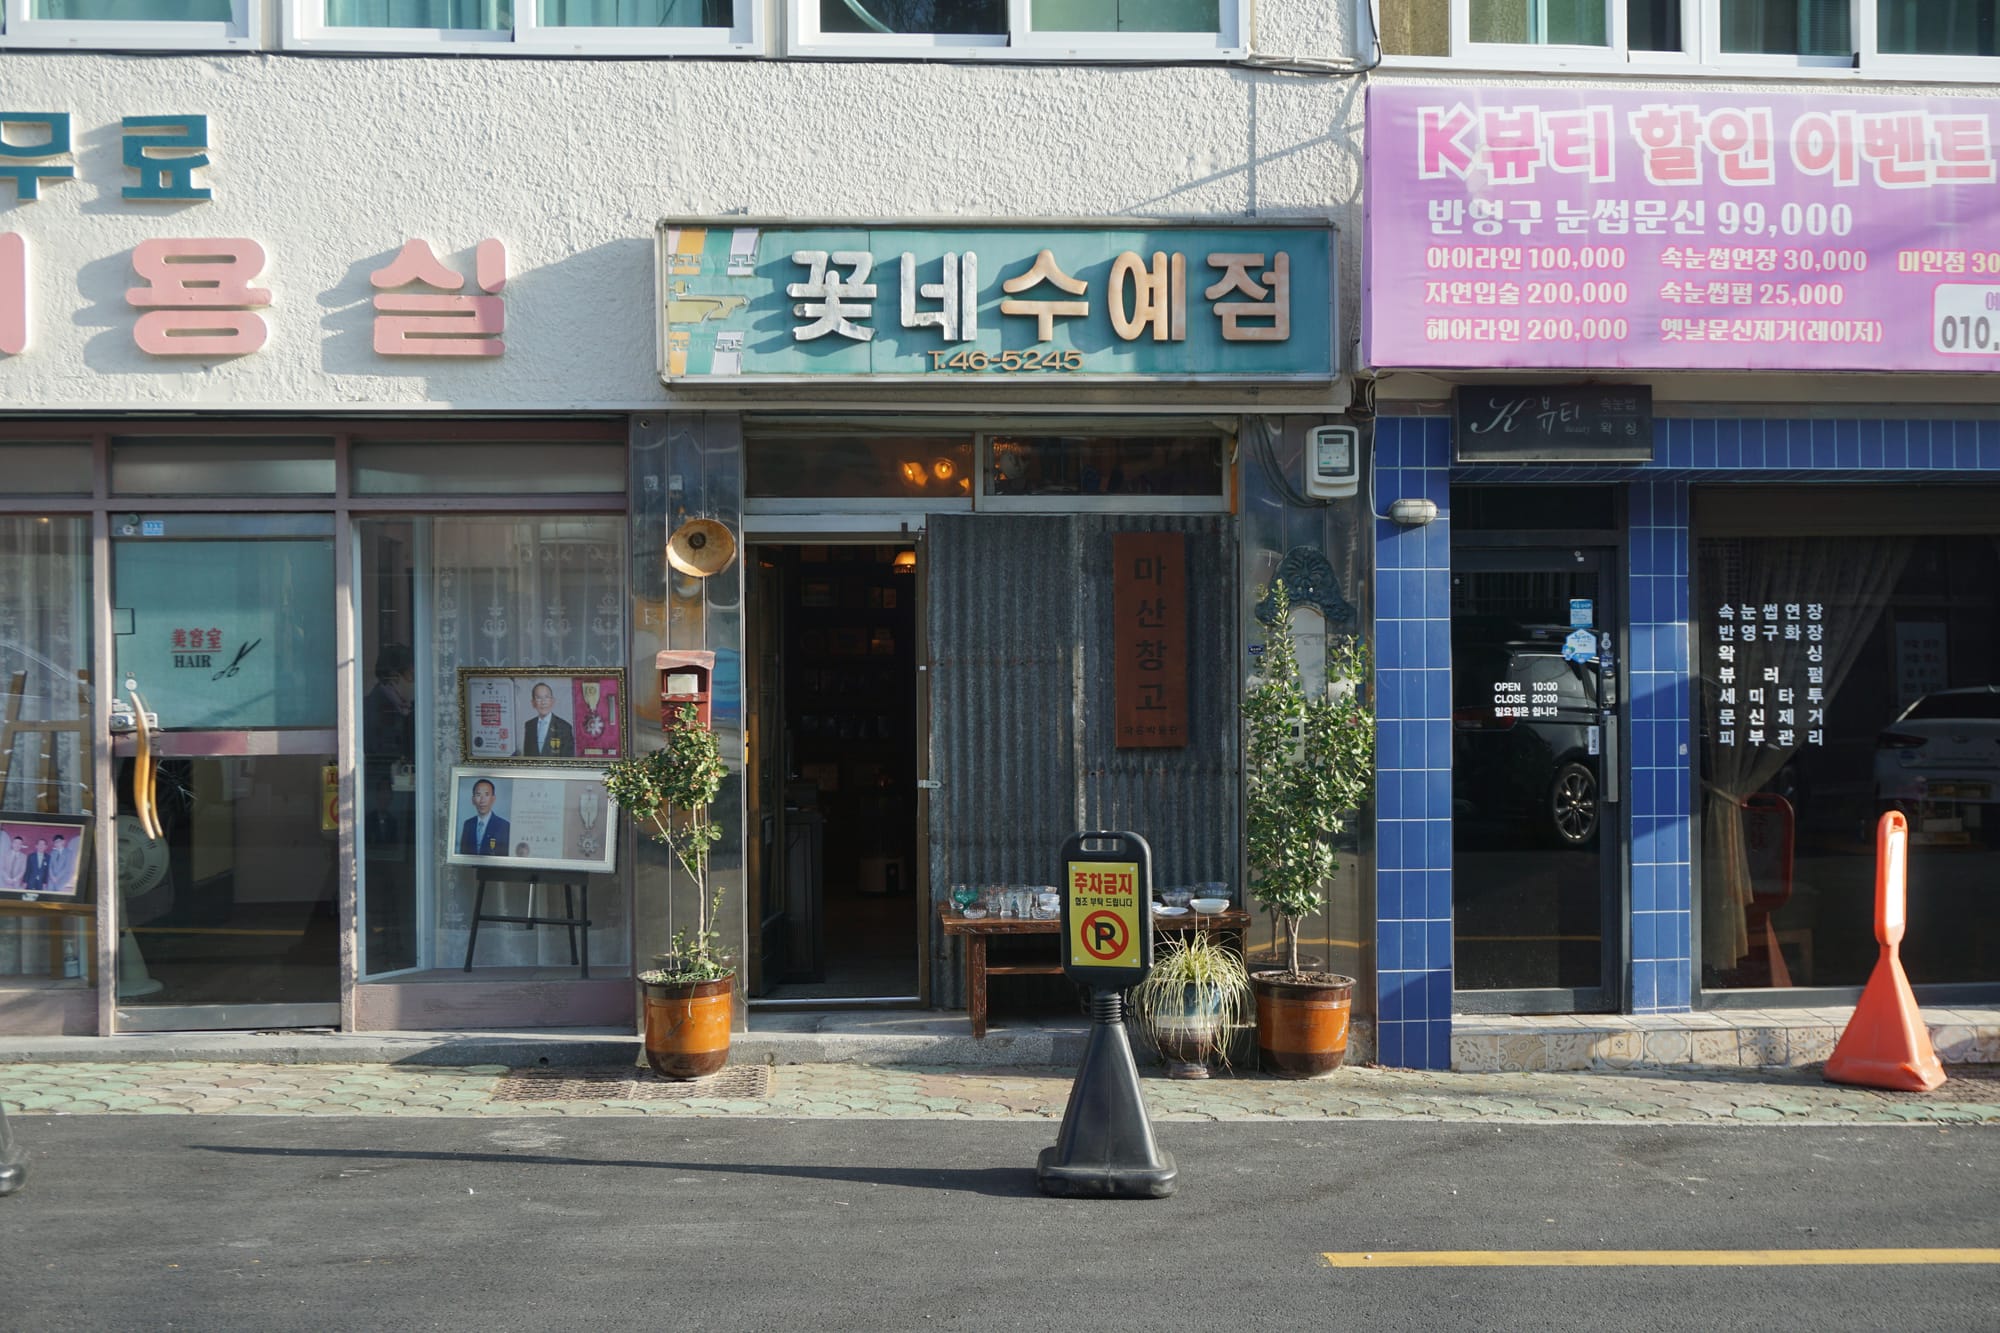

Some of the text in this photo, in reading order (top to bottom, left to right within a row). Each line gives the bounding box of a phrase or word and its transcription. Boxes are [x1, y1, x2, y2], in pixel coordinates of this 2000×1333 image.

[1417, 101, 1996, 190] K뷰티 할인 이벤트
[1428, 199, 1853, 238] 반영구 눈썹문신 99,000
[1426, 247, 1626, 270] 아이라인 100,000
[1660, 247, 1868, 272] 속눈썹연장 30,000
[1898, 250, 1966, 273] 미인점
[786, 248, 1292, 342] 꽃네수예점
[1425, 282, 1629, 305] 자연입술 200,000
[1660, 281, 1844, 306] 속눈썹펌 25,000
[1425, 318, 1629, 341] 헤어라인 200,000
[927, 350, 1085, 371] T.46-5245
[171, 628, 222, 648] 美容室
[1133, 554, 1168, 711] 마산창고
[174, 655, 211, 668] HAIR
[1494, 682, 1558, 691] OPEN 10:00
[1494, 694, 1558, 704] CLOSE 20:00
[1494, 706, 1529, 717] 일요일은
[1075, 872, 1133, 895] 주차금지
